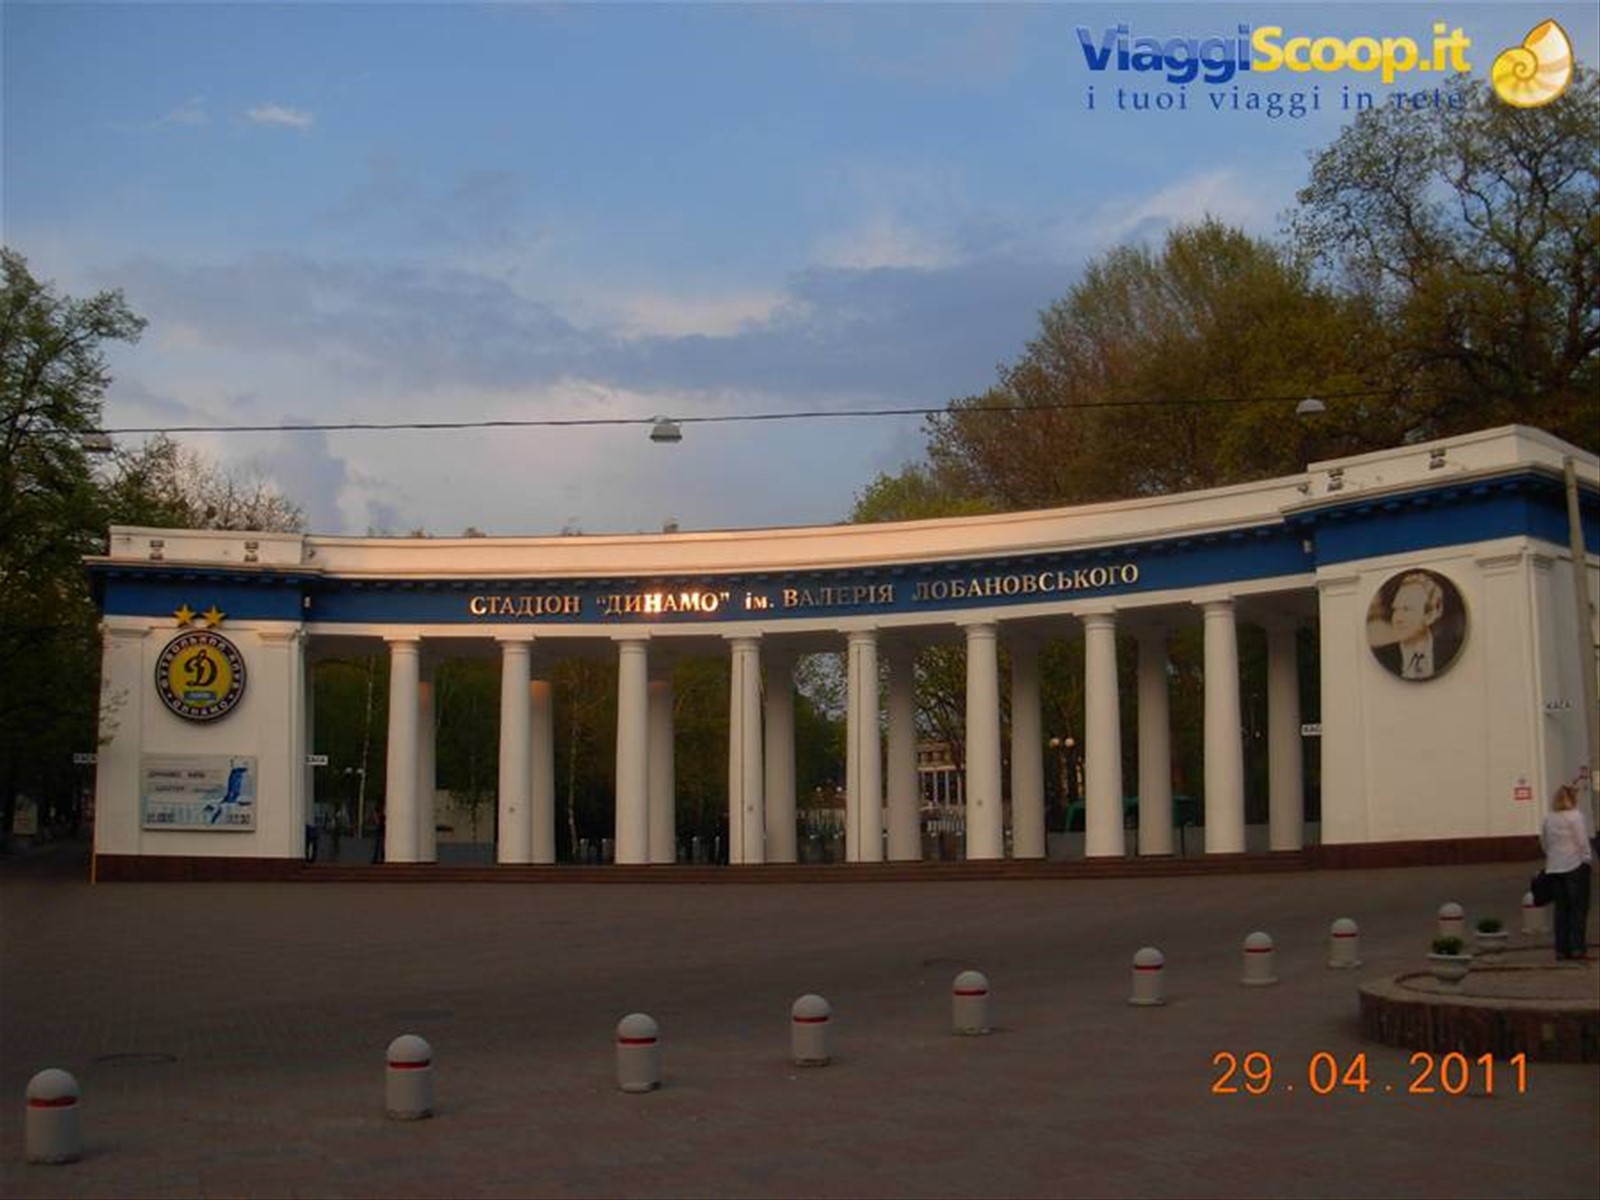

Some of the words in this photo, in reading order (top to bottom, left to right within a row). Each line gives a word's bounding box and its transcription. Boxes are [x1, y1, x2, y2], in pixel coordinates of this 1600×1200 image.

[469, 594, 581, 617] СТАДІОН
[596, 590, 730, 616] "ДИНАМО"
[745, 592, 775, 610] ім.
[783, 583, 895, 608] ВАЛЕРІЯ
[911, 563, 1139, 602] ЛОБАНОВСЬКОГО
